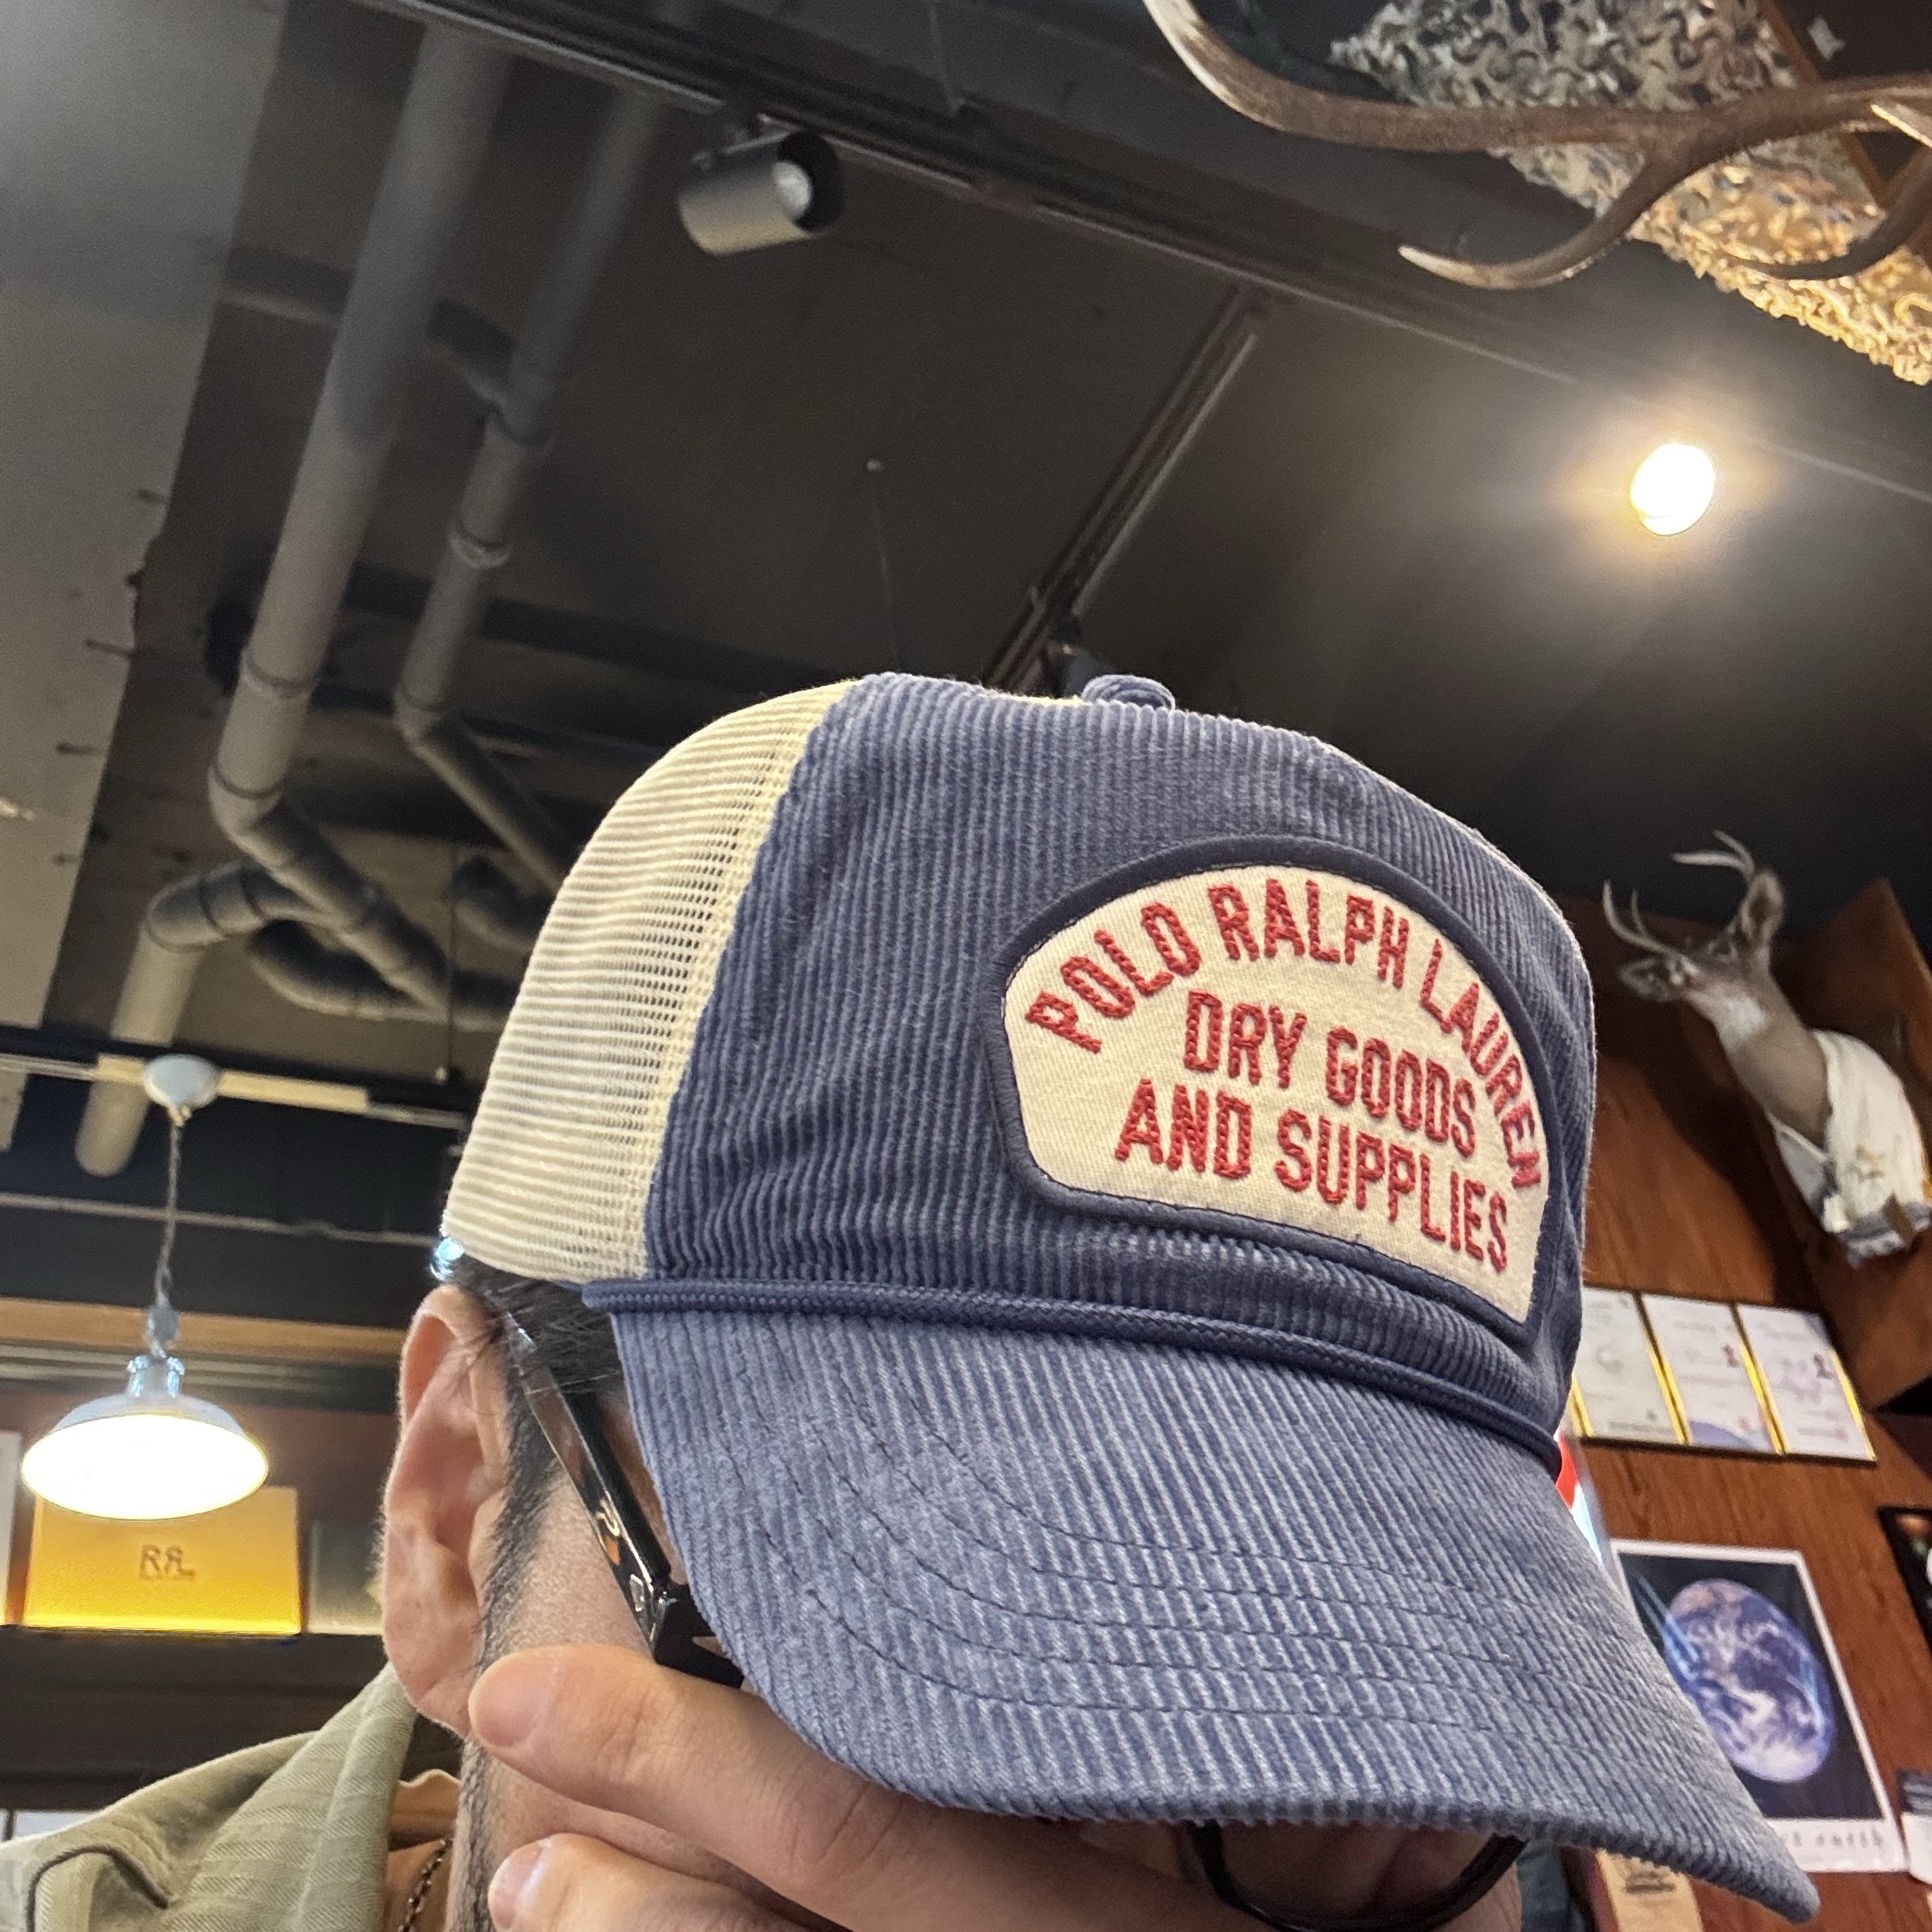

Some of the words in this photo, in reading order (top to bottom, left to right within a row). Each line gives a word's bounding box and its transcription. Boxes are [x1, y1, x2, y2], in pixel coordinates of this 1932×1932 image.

[1024, 901, 1203, 1054] POLO
[1207, 878, 1411, 988] RALPH
[1420, 938, 1542, 1188] LAUREN
[1183, 989, 1308, 1089] DRY
[1325, 1025, 1477, 1158] GOODS
[1114, 1078, 1254, 1179] AND
[1274, 1107, 1508, 1272] SUPPLIES
